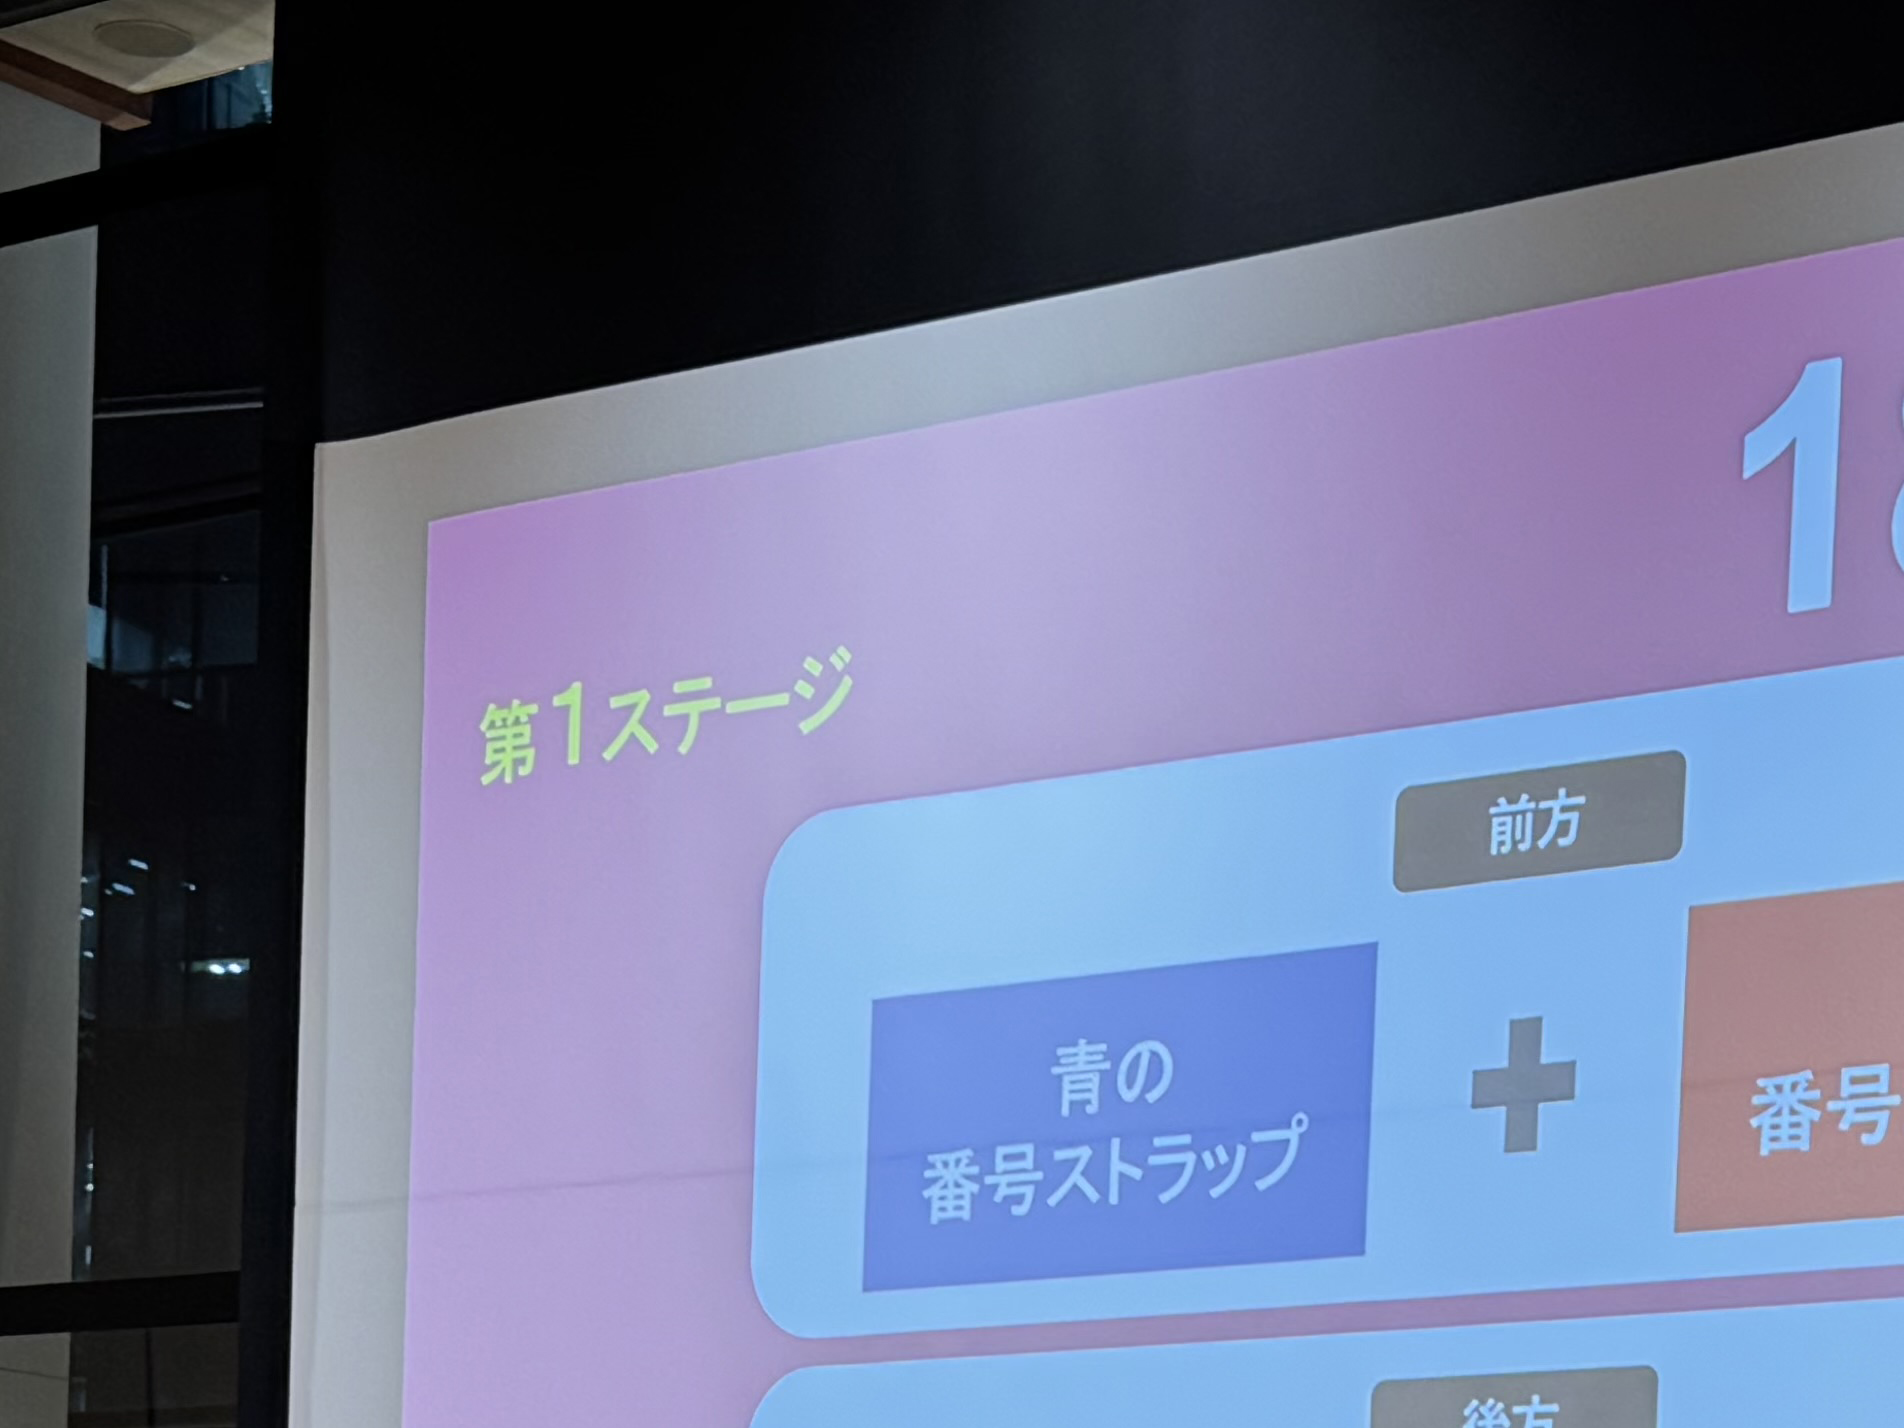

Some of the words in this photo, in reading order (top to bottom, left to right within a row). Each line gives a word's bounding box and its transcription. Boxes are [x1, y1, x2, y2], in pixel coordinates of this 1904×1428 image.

[479, 645, 853, 786] 第1ステージ
[1489, 788, 1586, 856] 前方
[1050, 1047, 1173, 1118] 青の
[922, 1113, 1309, 1226] 番号ストラップ
